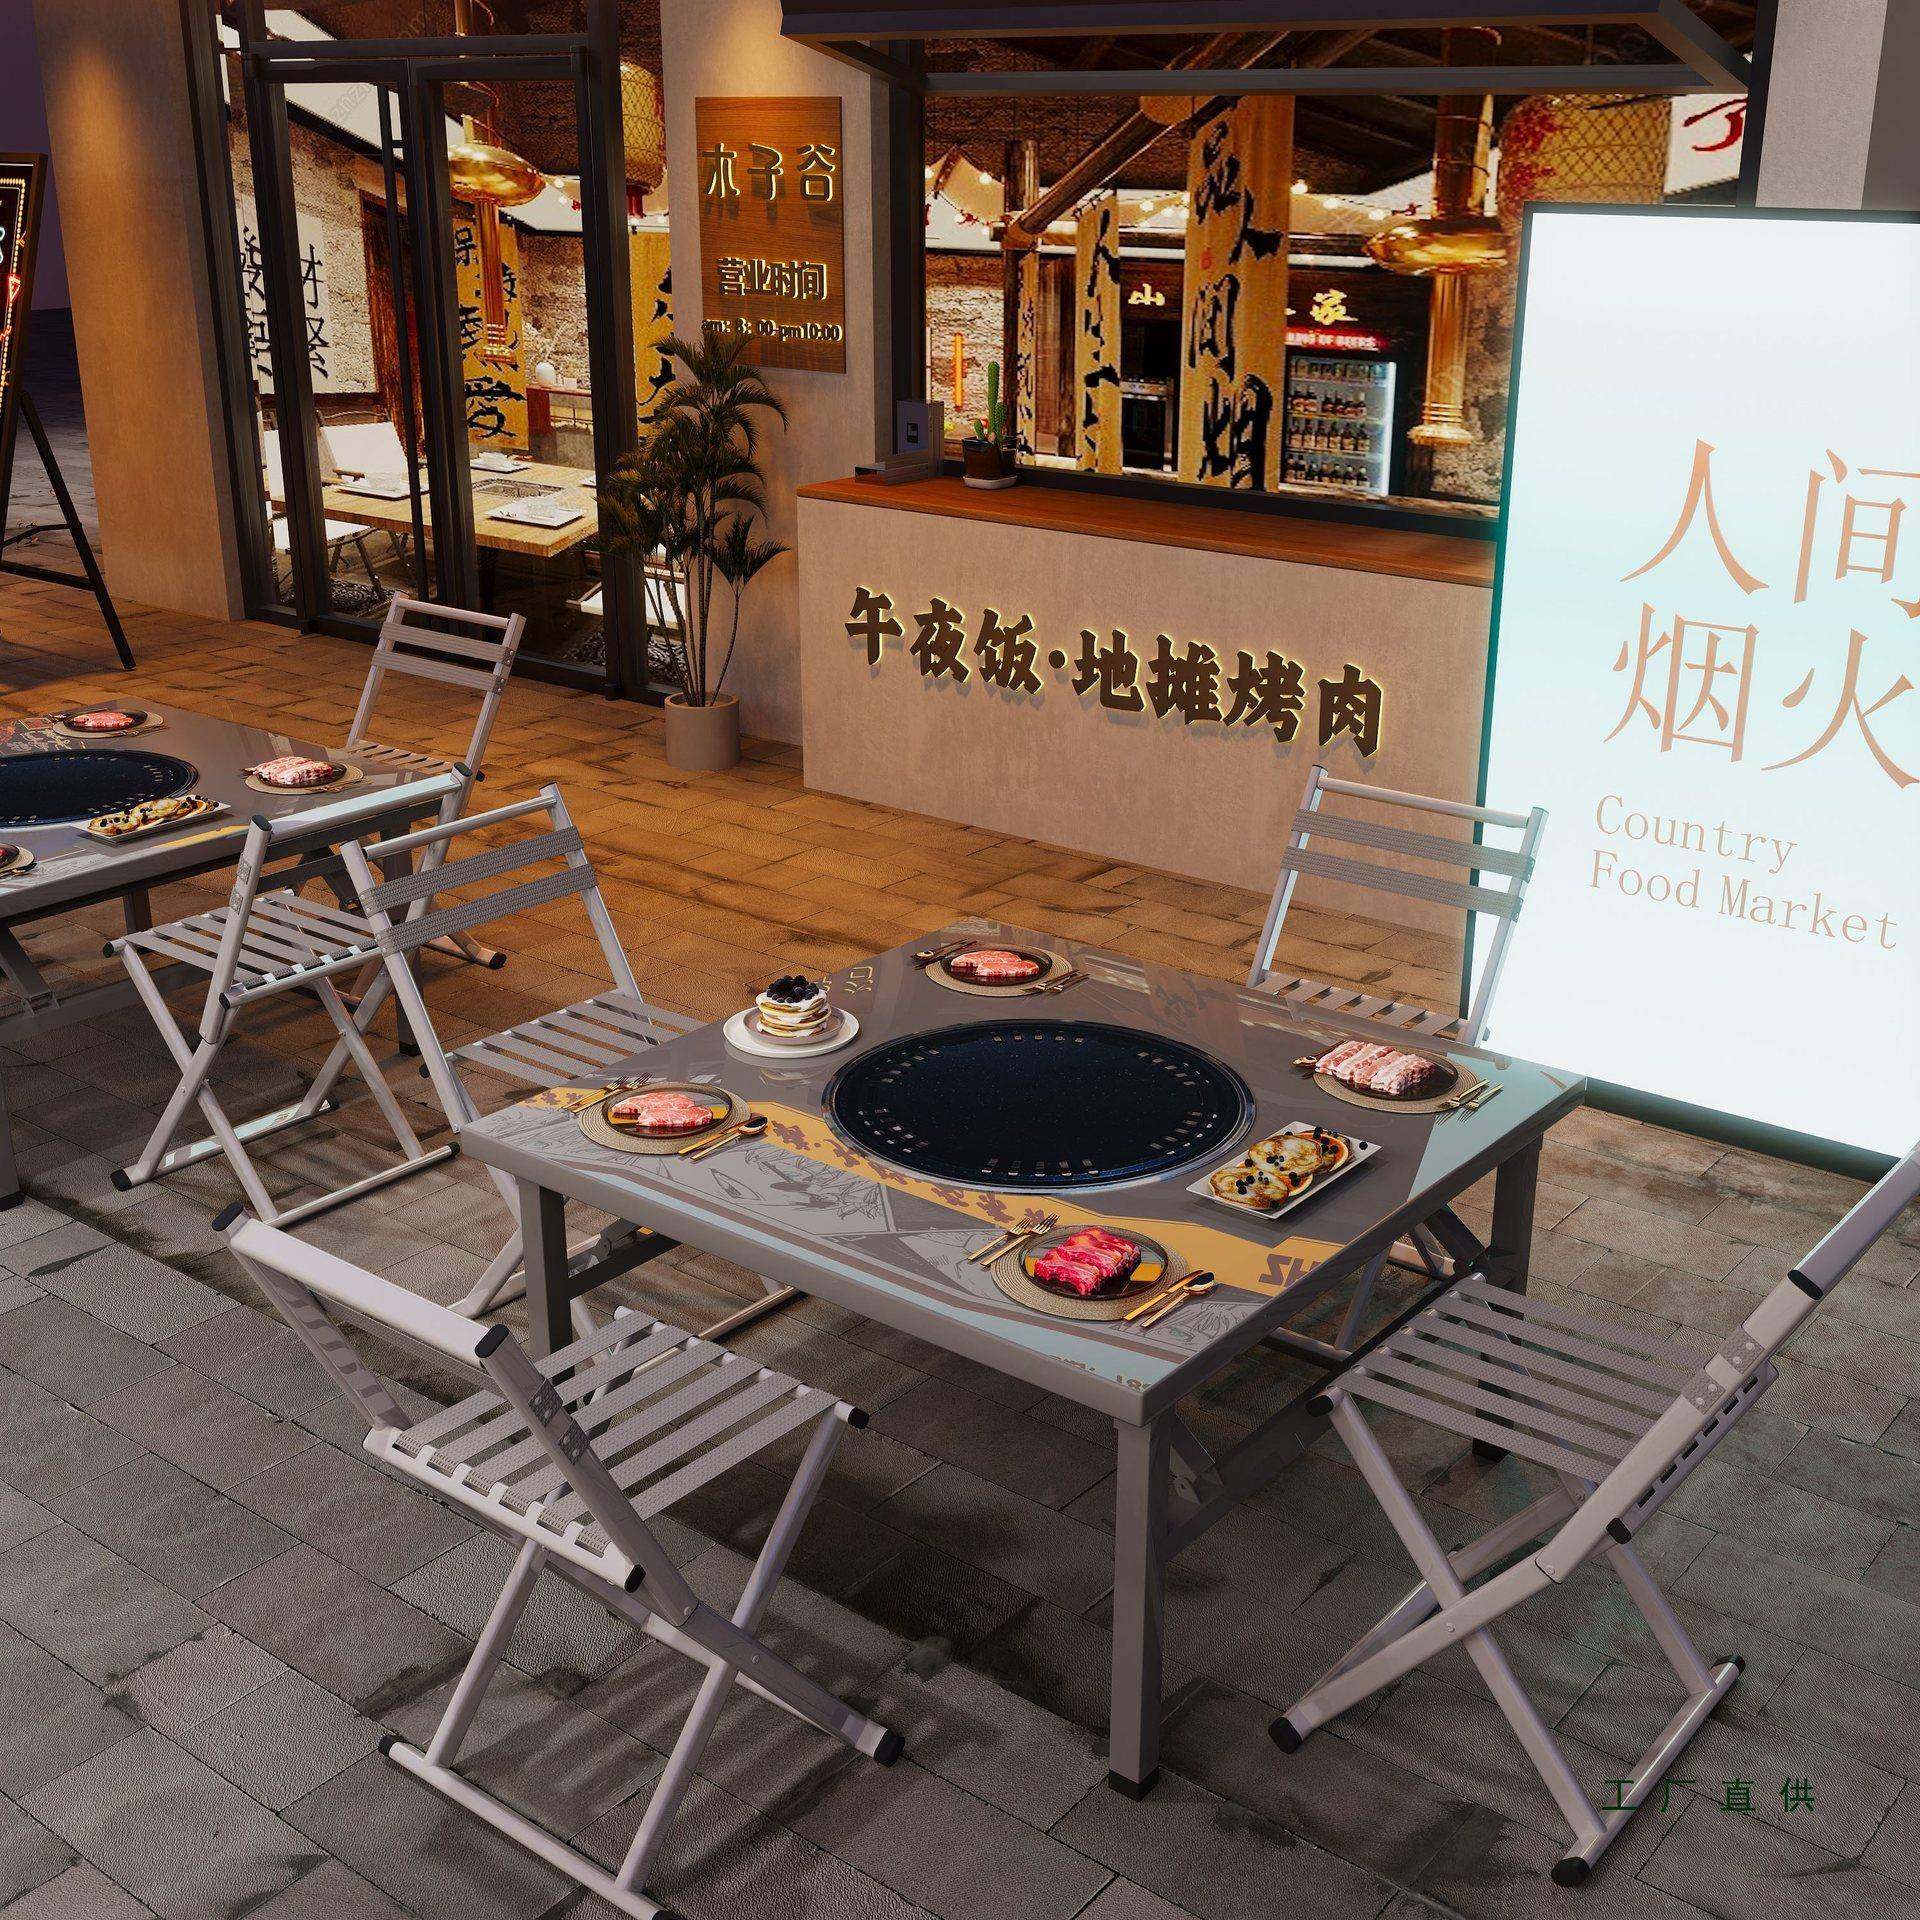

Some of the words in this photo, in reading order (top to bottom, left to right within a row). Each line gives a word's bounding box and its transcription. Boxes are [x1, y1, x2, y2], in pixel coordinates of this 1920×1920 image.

[701, 143, 837, 202] 木子谷
[716, 257, 828, 300] 营业时间
[1619, 438, 1920, 619] 人间
[844, 586, 1383, 758] 午夜饭·地摊烤肉
[1603, 602, 1920, 790] 烟火
[1595, 794, 1798, 876] Country
[1589, 849, 1701, 908] Food
[1717, 874, 1899, 950] Market
